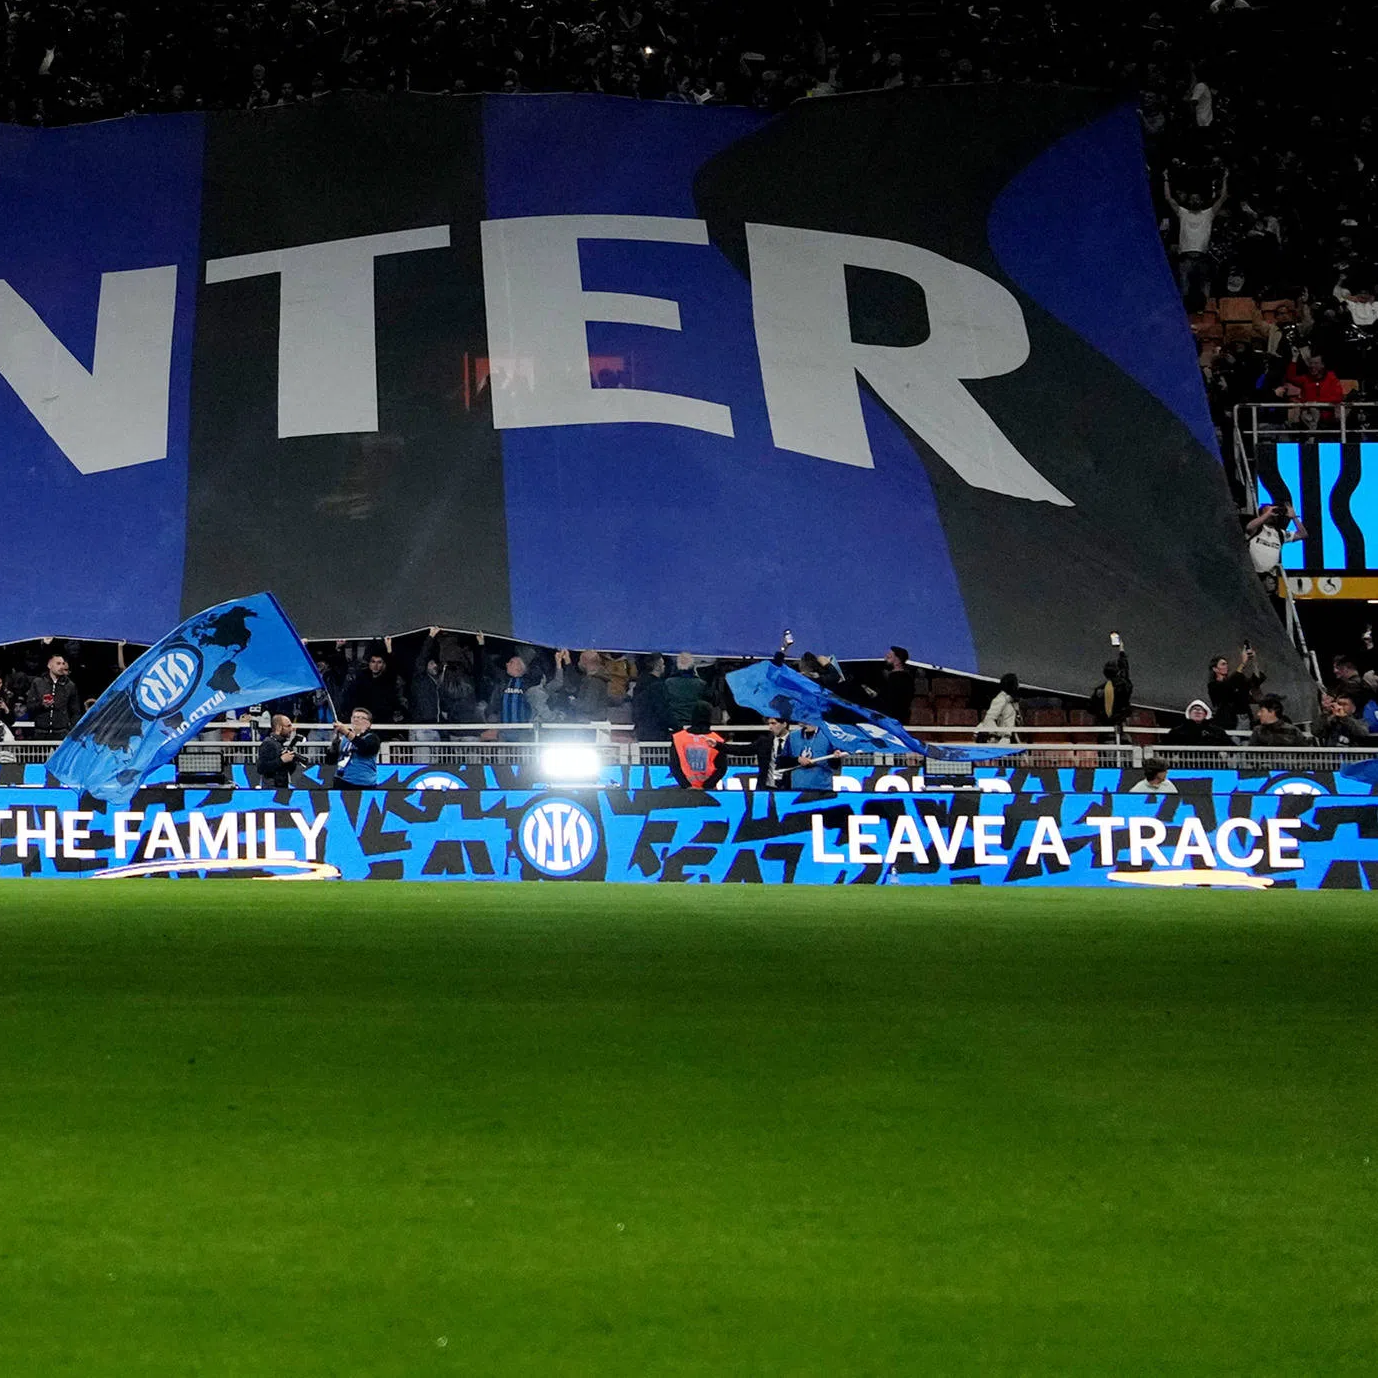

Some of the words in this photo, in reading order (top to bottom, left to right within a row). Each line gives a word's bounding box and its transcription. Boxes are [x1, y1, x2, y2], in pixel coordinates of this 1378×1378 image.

[113, 810, 331, 862] FAMILY
[810, 813, 1007, 866] LEAVE
[1026, 815, 1071, 866] A
[1086, 815, 1305, 871] TRACE
